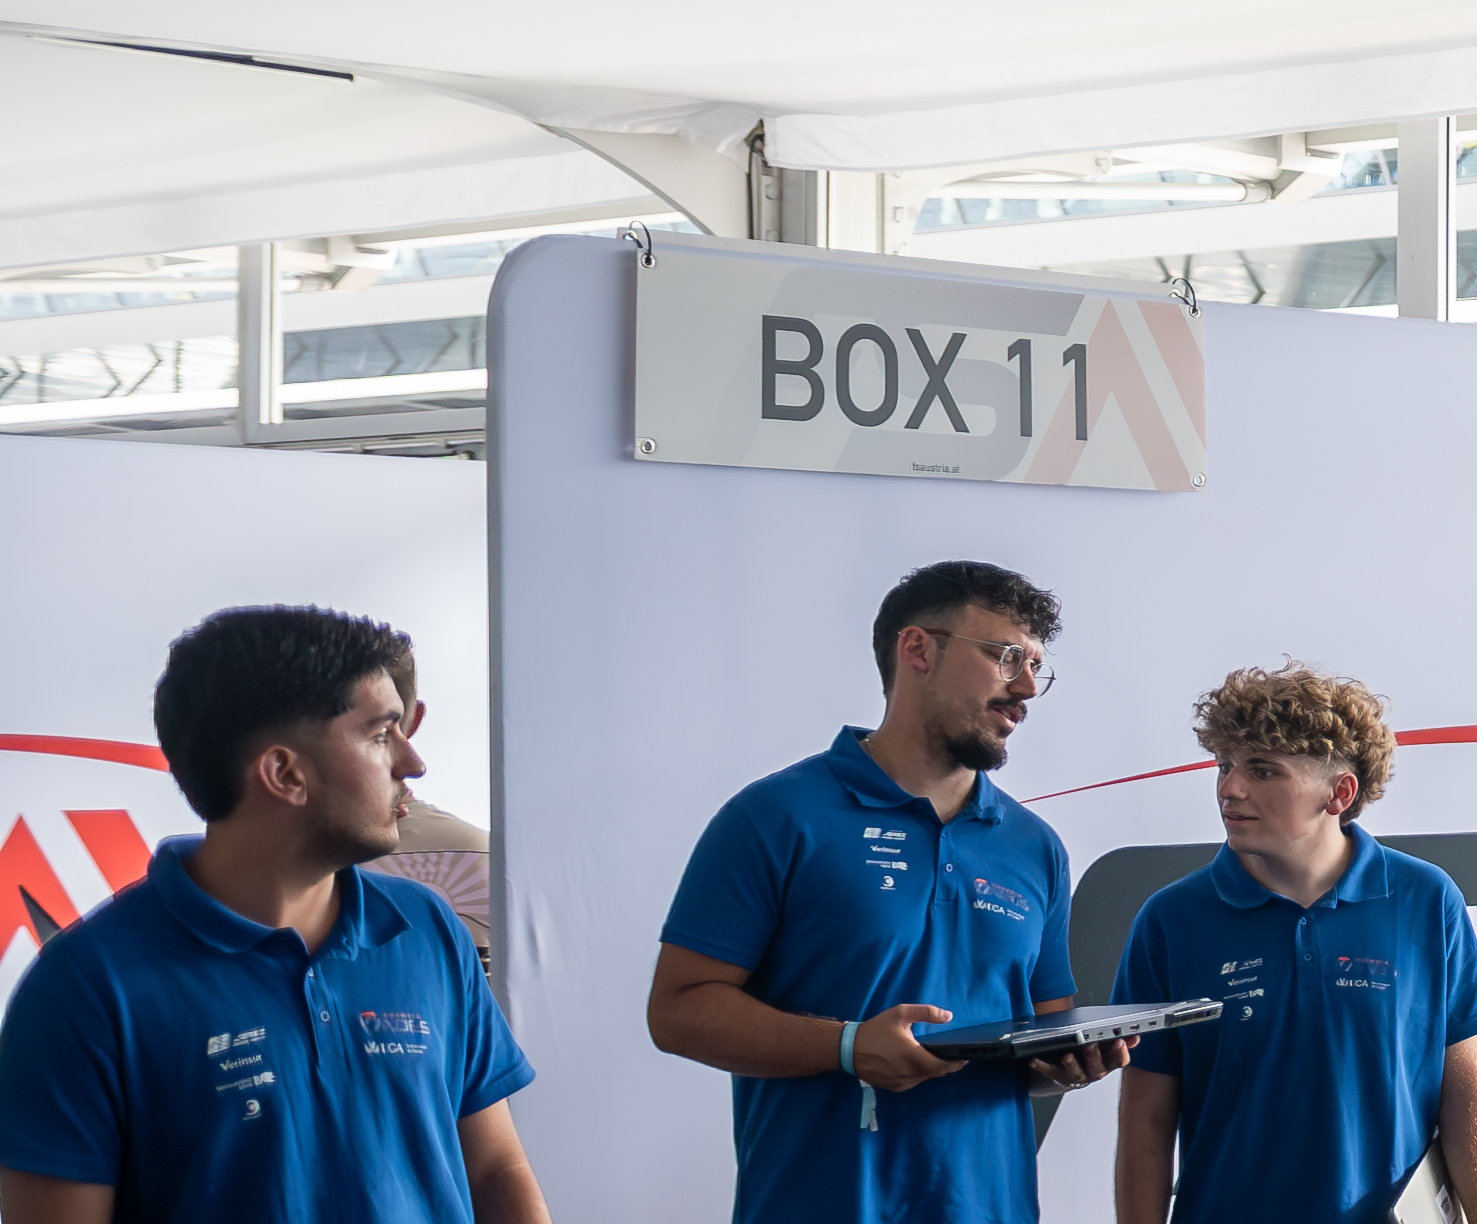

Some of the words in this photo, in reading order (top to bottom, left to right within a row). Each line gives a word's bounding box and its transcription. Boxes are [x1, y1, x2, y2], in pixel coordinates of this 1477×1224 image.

[761, 314, 970, 434] BOX
[1006, 338, 1088, 441] 11
[912, 461, 960, 475] fsaustria.at
